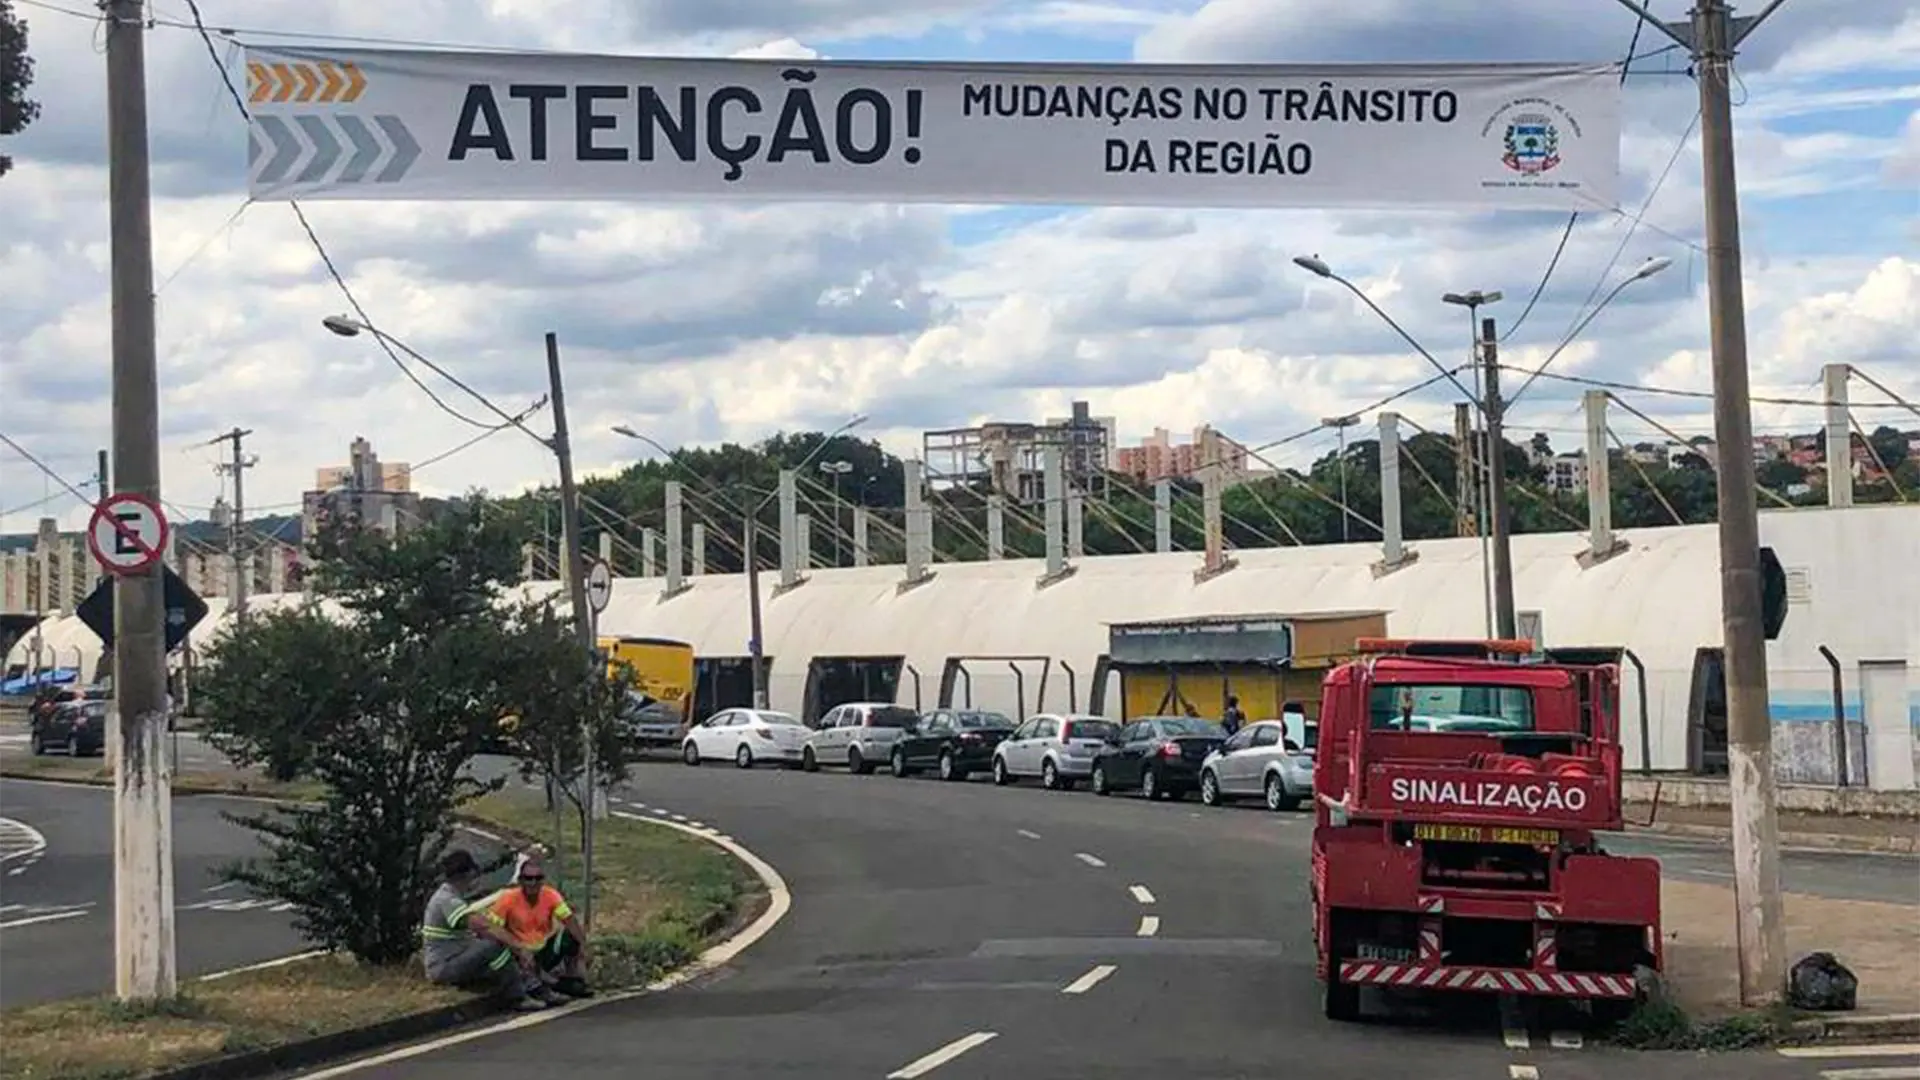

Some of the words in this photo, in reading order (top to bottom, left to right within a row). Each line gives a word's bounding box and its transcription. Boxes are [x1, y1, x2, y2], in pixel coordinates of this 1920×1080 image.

[448, 67, 923, 181] ATENÇÃO!
[964, 84, 1182, 126] MUDANÇAS
[1194, 88, 1246, 120] NO
[1258, 81, 1456, 122] TRÂNSITO
[1106, 139, 1156, 172] DA
[1169, 134, 1311, 174] REGIÃO
[1391, 778, 1586, 814] SINALIZAÇÃO
